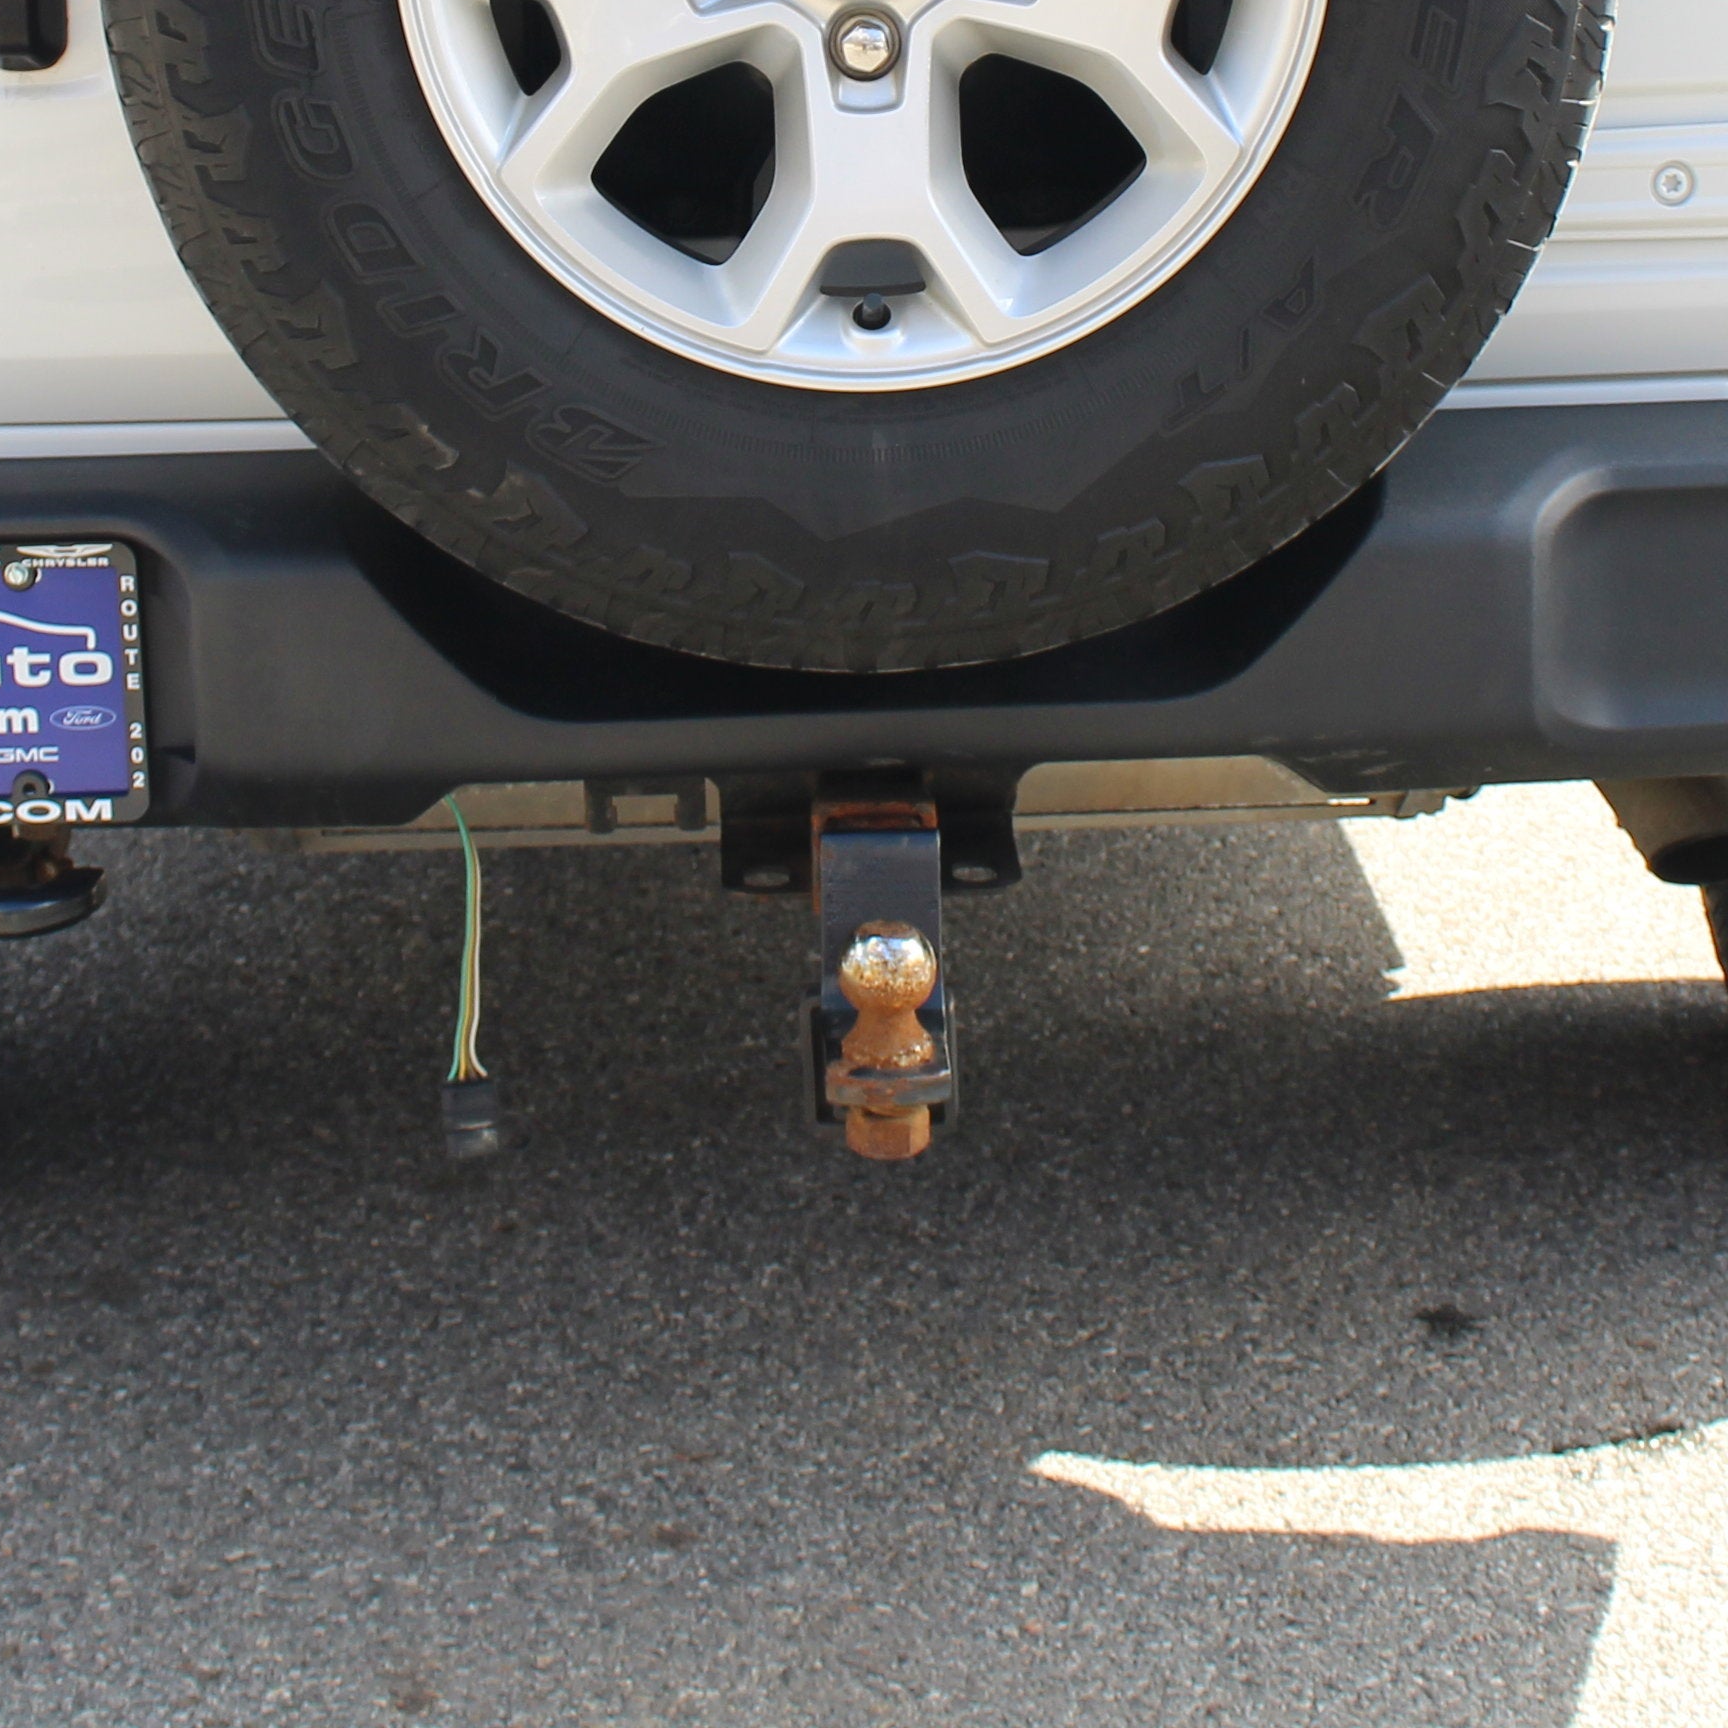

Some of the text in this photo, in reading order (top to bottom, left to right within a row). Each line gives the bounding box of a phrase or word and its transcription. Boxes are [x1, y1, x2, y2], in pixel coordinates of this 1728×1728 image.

[22, 557, 110, 568] CHRYSLER
[120, 575, 146, 789] ROUTE 202
[59, 706, 105, 728] Ford
